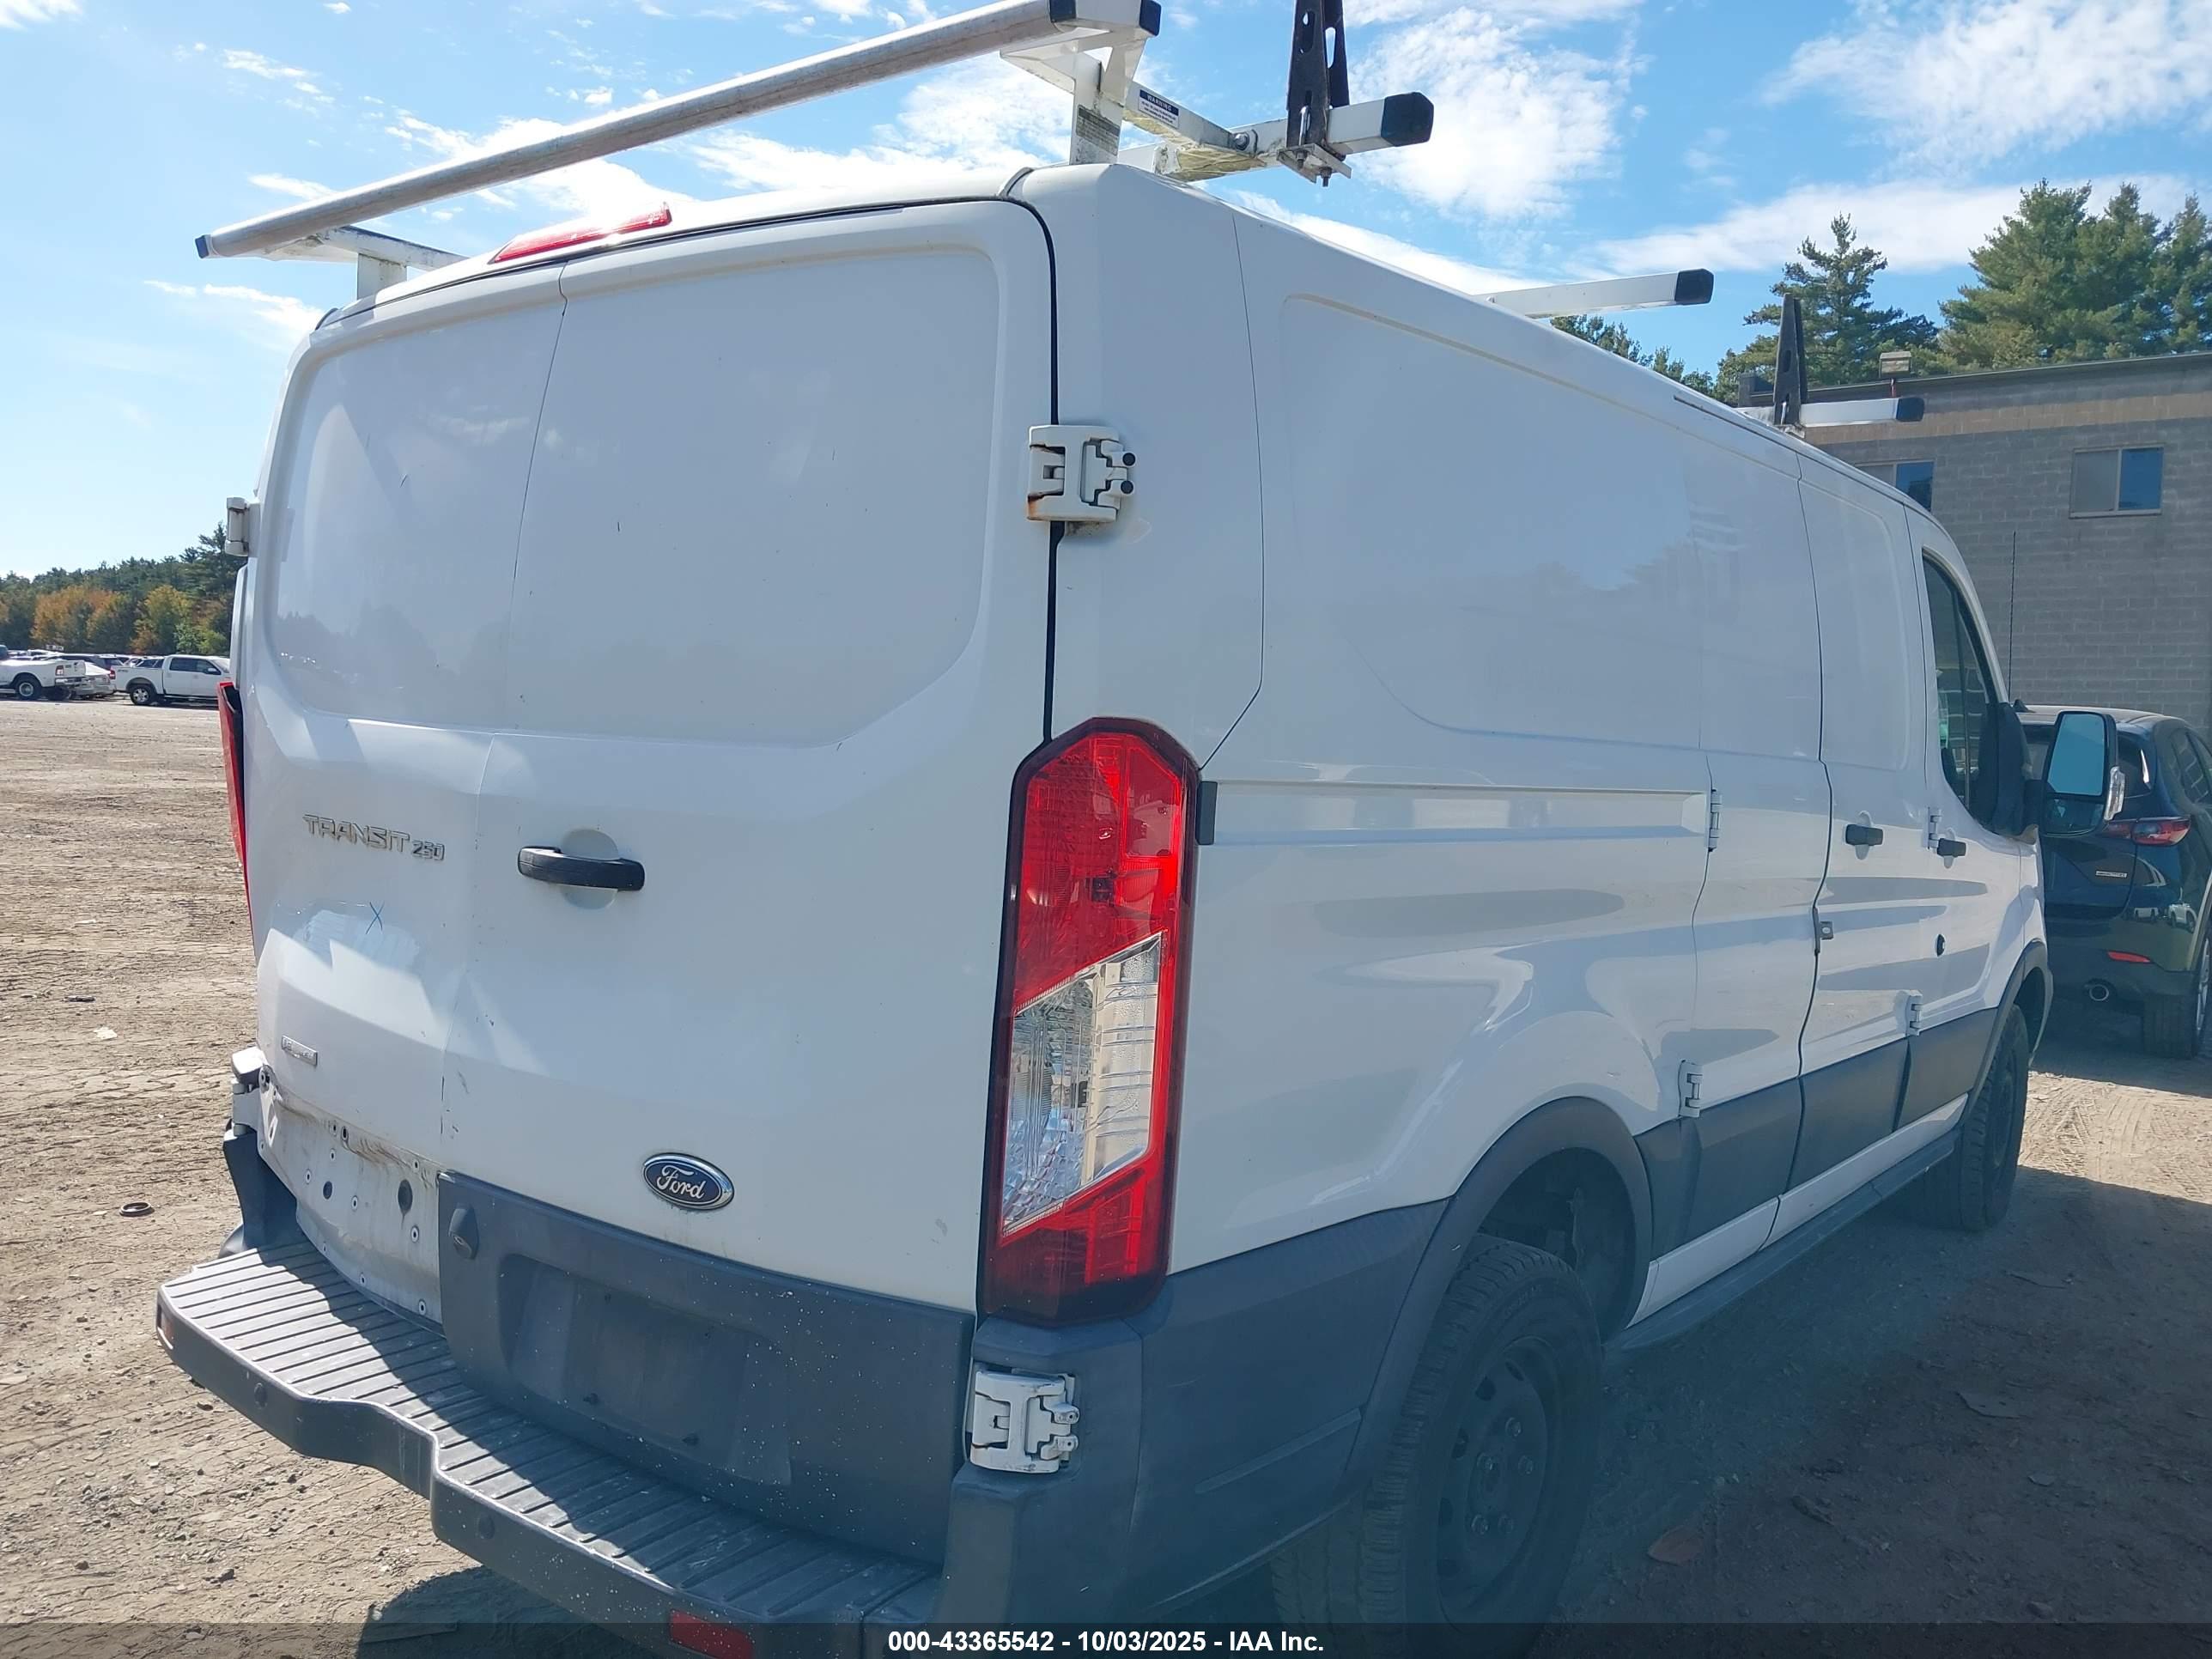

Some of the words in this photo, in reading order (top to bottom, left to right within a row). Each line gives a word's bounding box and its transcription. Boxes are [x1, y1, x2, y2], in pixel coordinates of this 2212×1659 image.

[1147, 94, 1172, 111] WARNING
[302, 814, 410, 852] TRANSIT
[412, 840, 446, 861] 250
[656, 1164, 707, 1200] Ford
